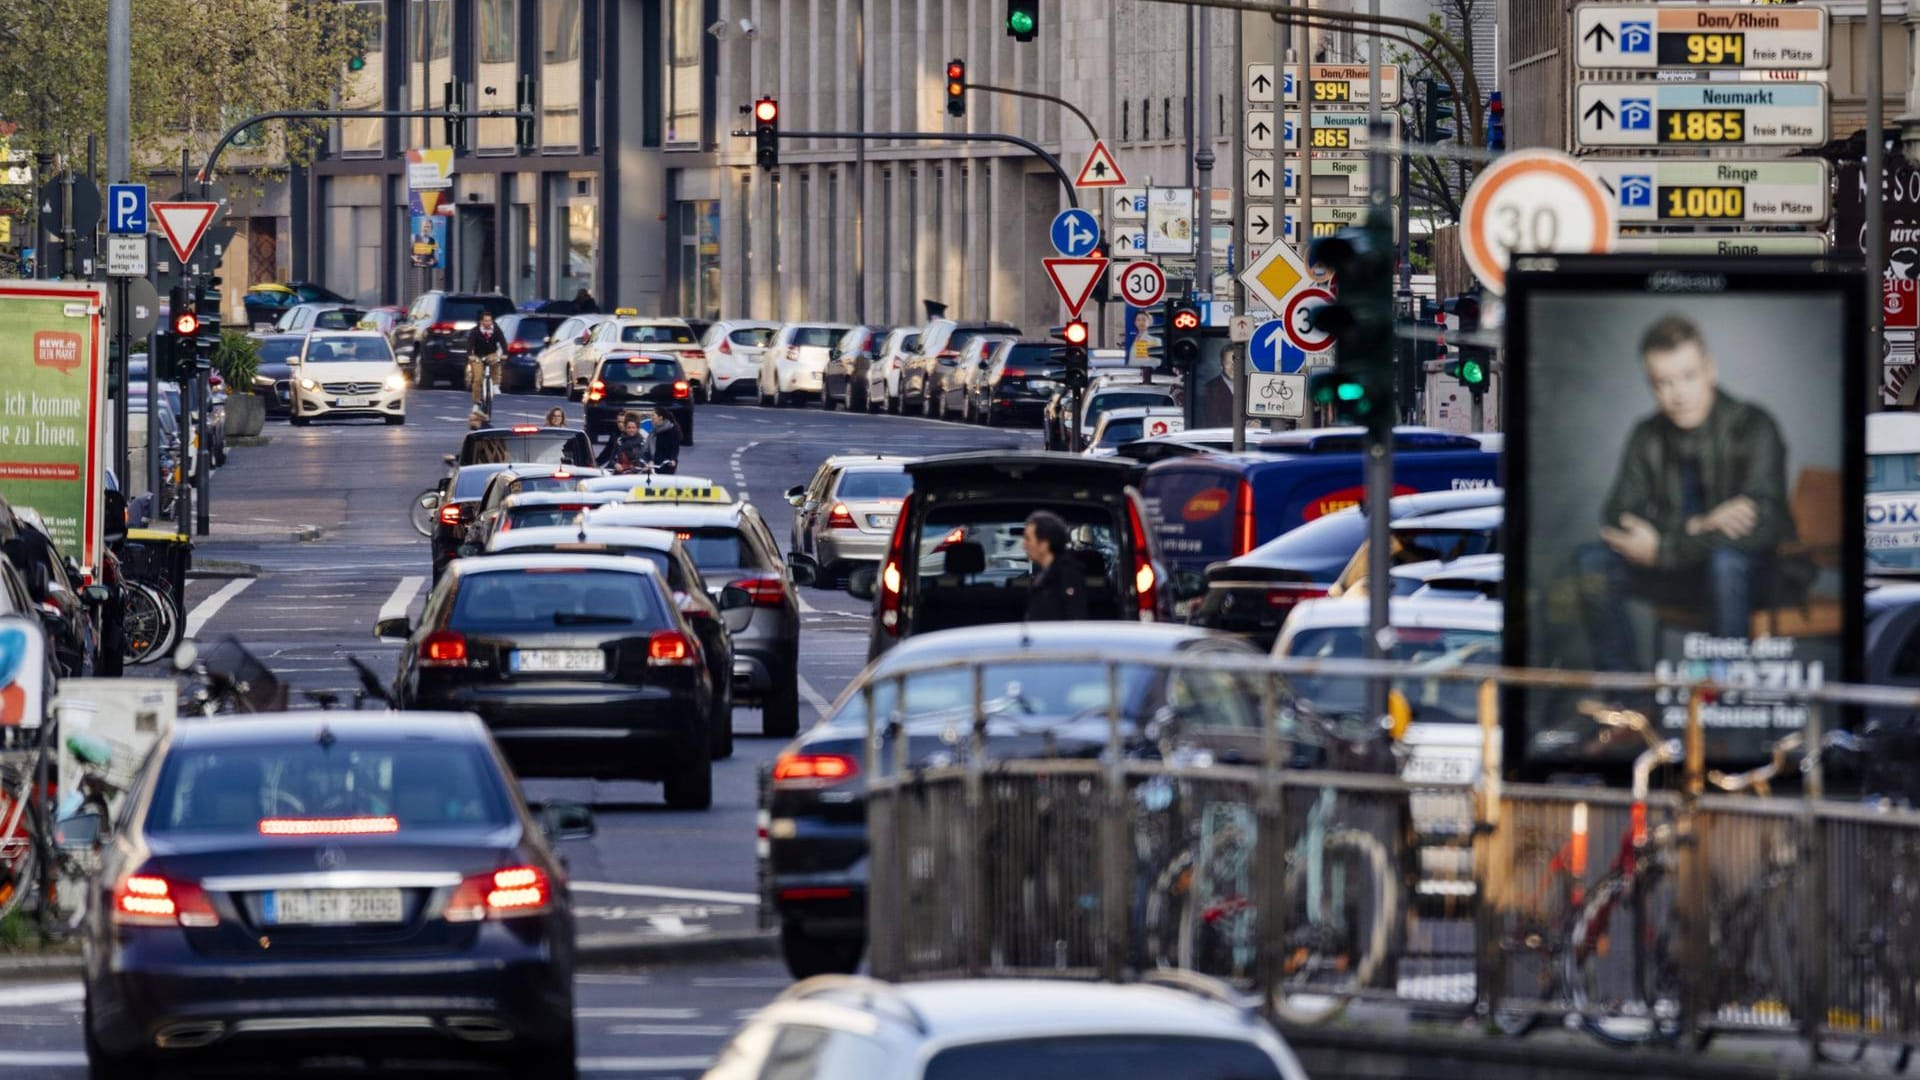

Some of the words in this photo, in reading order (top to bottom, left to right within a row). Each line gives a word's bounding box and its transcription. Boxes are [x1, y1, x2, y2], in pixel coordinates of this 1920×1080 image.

[1697, 12, 1780, 29] Dom/Rhein
[1687, 35, 1742, 64] 994
[1752, 49, 1777, 60] freie
[1781, 48, 1813, 61] Plätze
[1315, 82, 1348, 100] 994
[1703, 89, 1774, 105] Neumarkt
[1324, 115, 1368, 126] Neumarkt
[1669, 112, 1742, 142] 1865
[1311, 129, 1348, 147] 865
[1752, 126, 1777, 137] freie
[1781, 125, 1813, 138] Plätze
[1332, 161, 1358, 173] Ringe
[1717, 165, 1758, 184] Ringe
[1668, 188, 1742, 218] 1000
[1752, 201, 1777, 213] freie
[1781, 201, 1813, 214] Plätze
[1332, 208, 1358, 220] Ringe
[1496, 203, 1558, 252] 30
[1130, 273, 1156, 294] 30
[1297, 307, 1313, 334] 3
[5, 391, 26, 416] ich
[32, 391, 82, 418] komme
[1267, 403, 1285, 412] frei
[15, 427, 30, 446] zu
[35, 420, 80, 447] Ihnen.
[654, 487, 704, 500] TAXI
